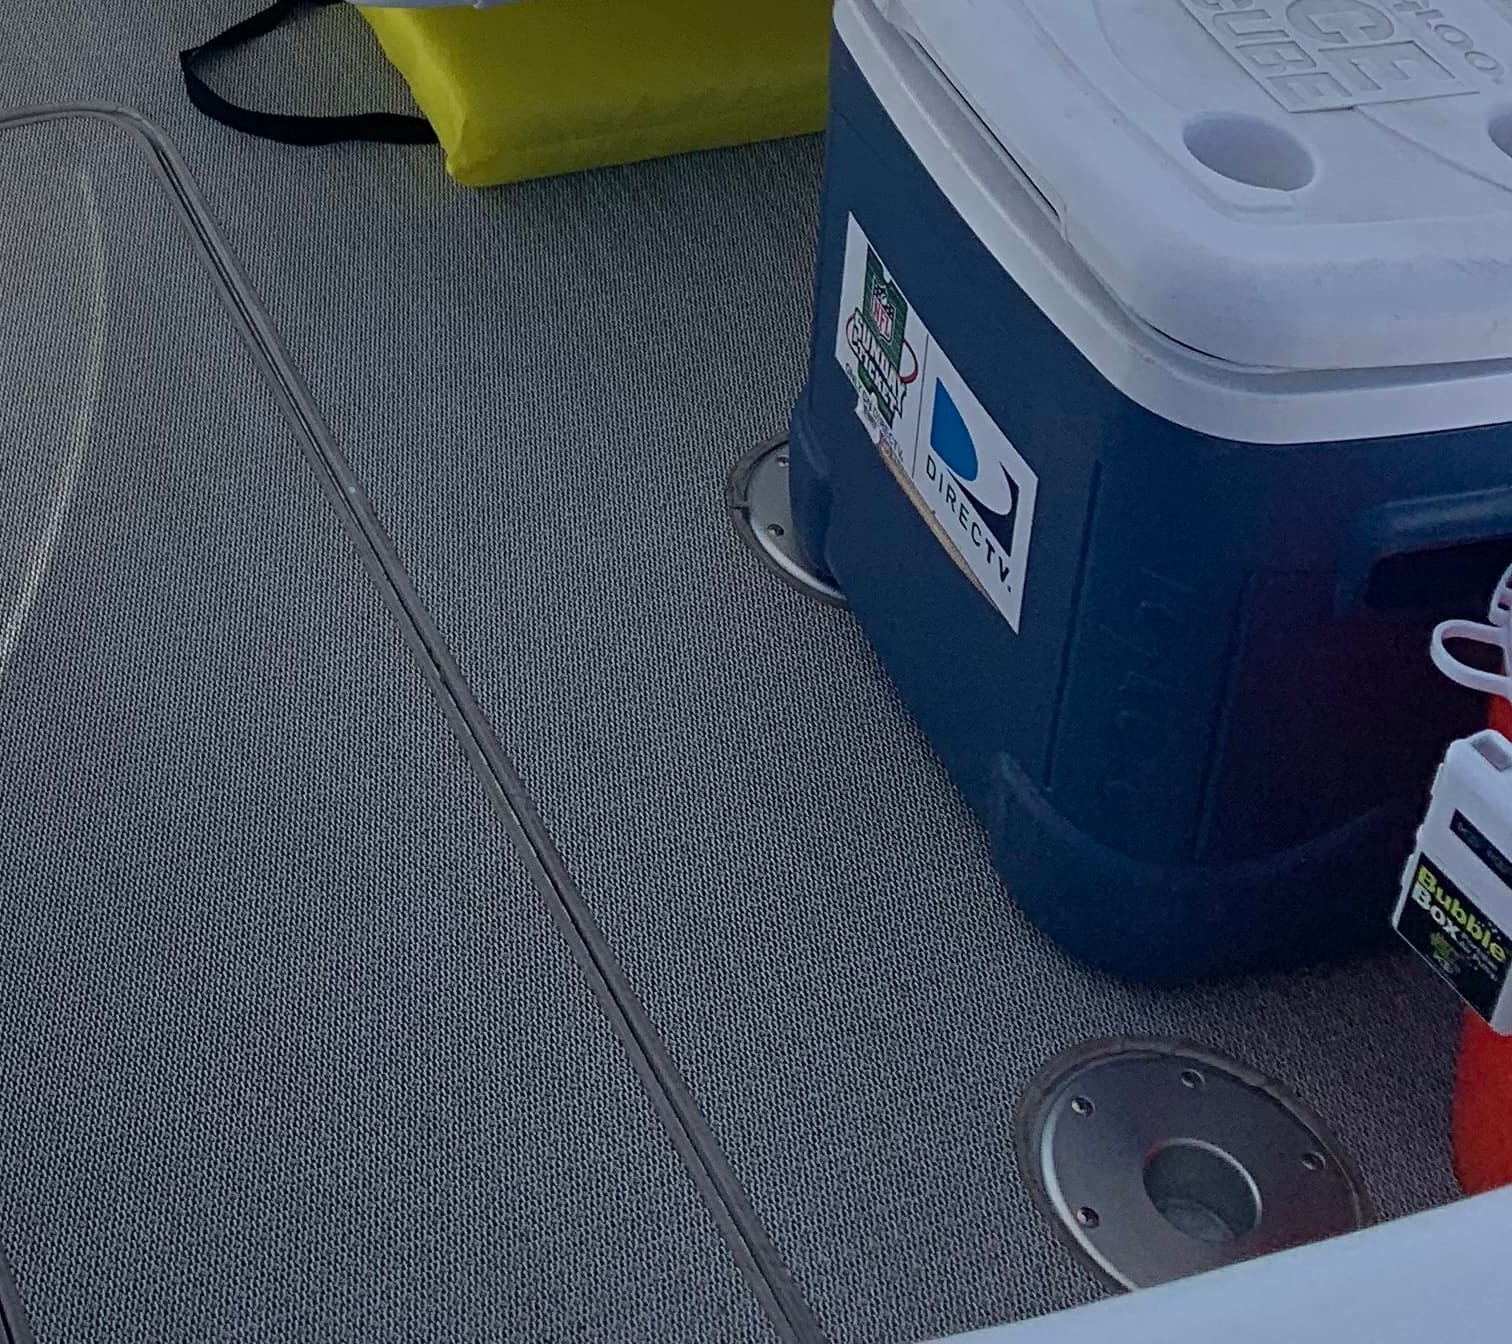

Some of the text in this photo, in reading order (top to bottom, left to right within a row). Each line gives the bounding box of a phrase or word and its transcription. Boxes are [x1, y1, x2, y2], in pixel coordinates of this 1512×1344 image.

[849, 310, 907, 417] SUNDAY
[872, 296, 893, 340] NFL
[1417, 865, 1506, 963] Bubble
